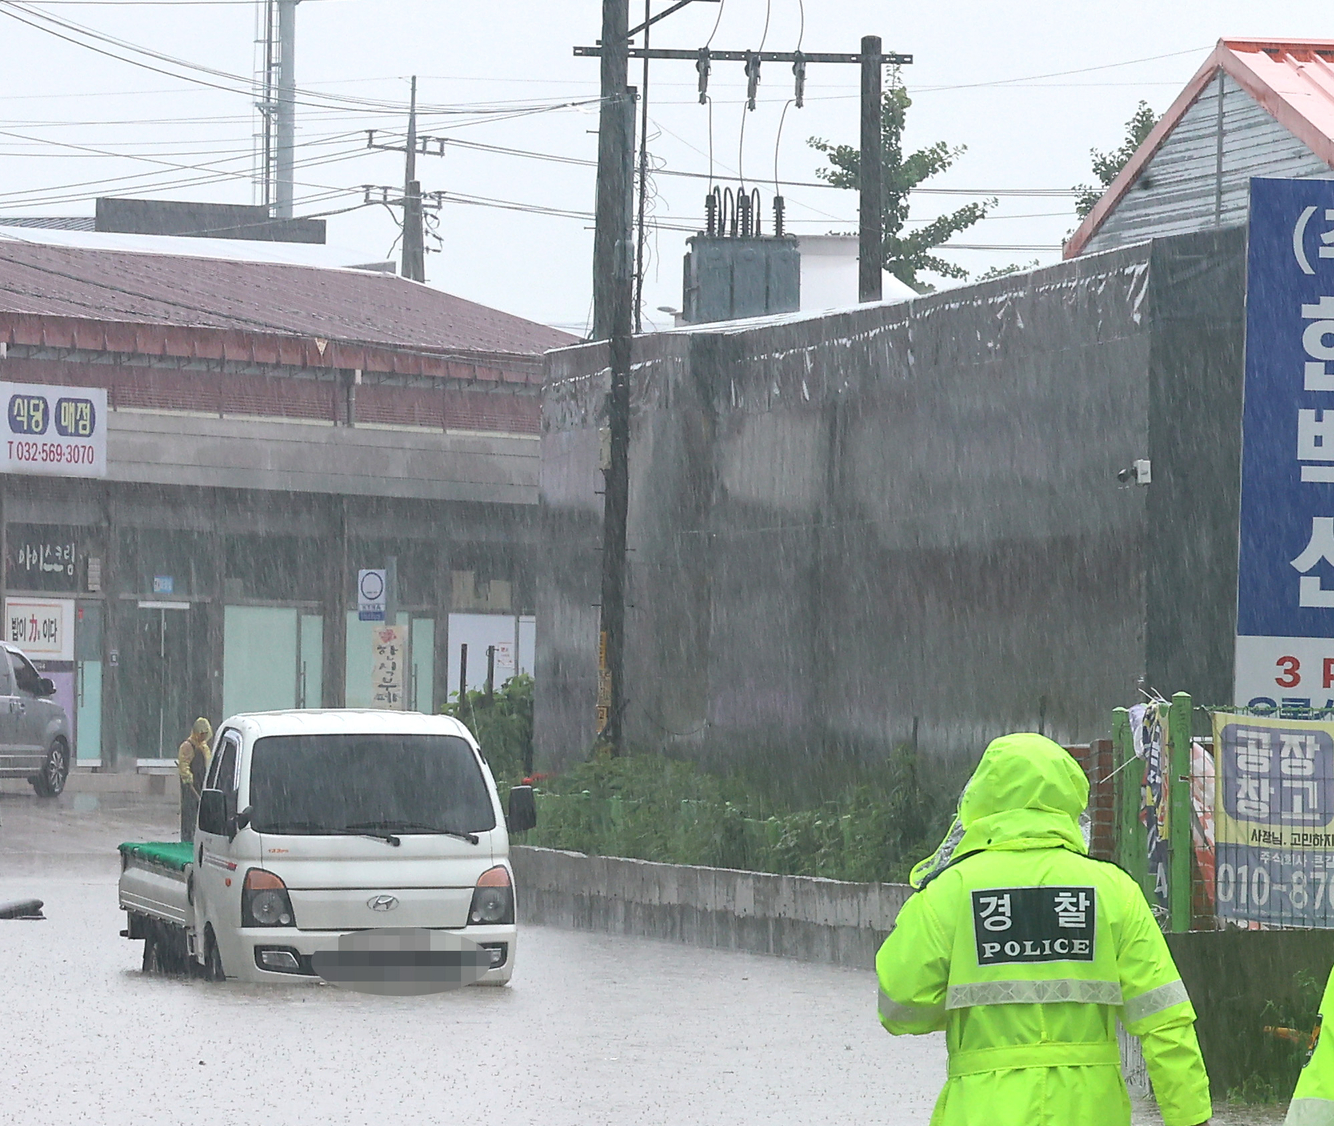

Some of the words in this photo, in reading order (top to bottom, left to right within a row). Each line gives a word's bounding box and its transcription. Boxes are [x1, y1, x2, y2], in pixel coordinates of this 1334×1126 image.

[13, 397, 45, 431] 식당
[61, 402, 91, 437] 매점
[7, 441, 14, 460] T
[1290, 832, 1334, 847] 고민하지
[982, 938, 1090, 958] POLICE
